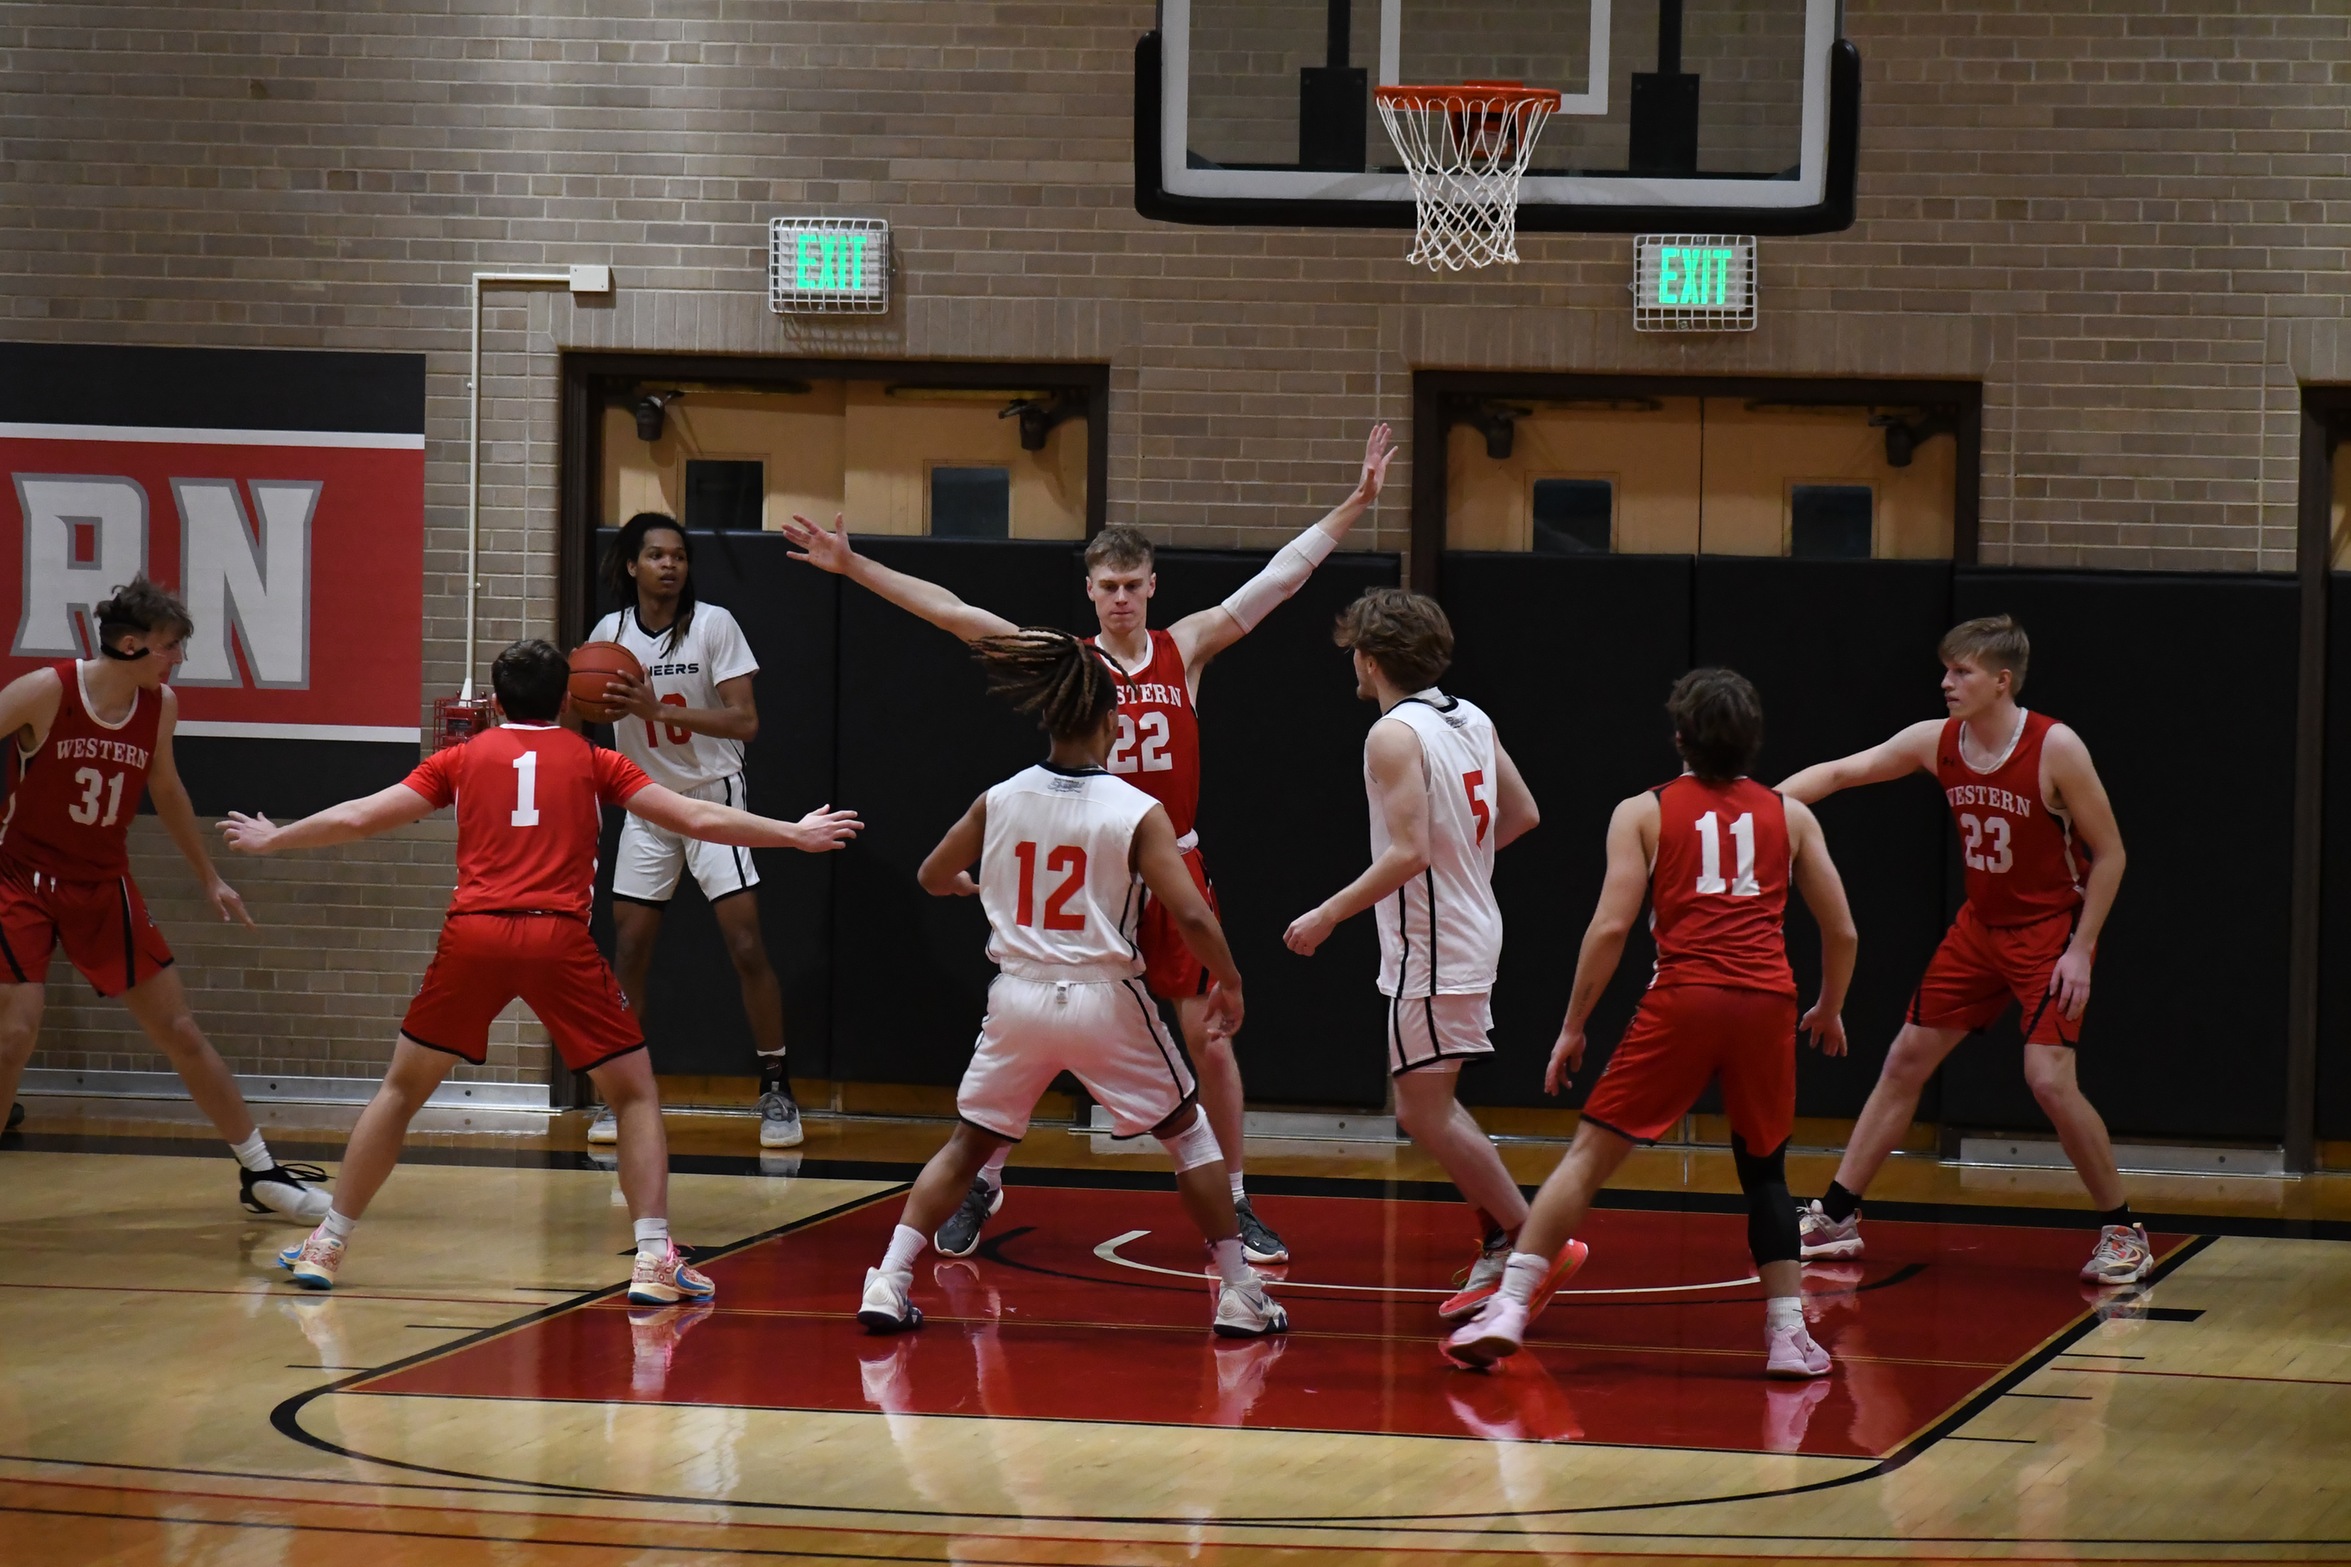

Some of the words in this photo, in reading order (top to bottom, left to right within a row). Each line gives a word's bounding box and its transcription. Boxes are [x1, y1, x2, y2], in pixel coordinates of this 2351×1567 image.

[797, 234, 867, 291] EXIT
[1658, 247, 1732, 305] EXIT
[9, 472, 324, 690] RN
[649, 663, 699, 677] EERS
[57, 738, 149, 770] WESTERN
[1107, 711, 1173, 774] 22
[68, 766, 125, 827] 31
[511, 751, 540, 827] 1
[1462, 769, 1490, 848] 5
[1695, 810, 1761, 896] 11
[1960, 812, 2014, 874] 23
[1014, 841, 1088, 931] 12
